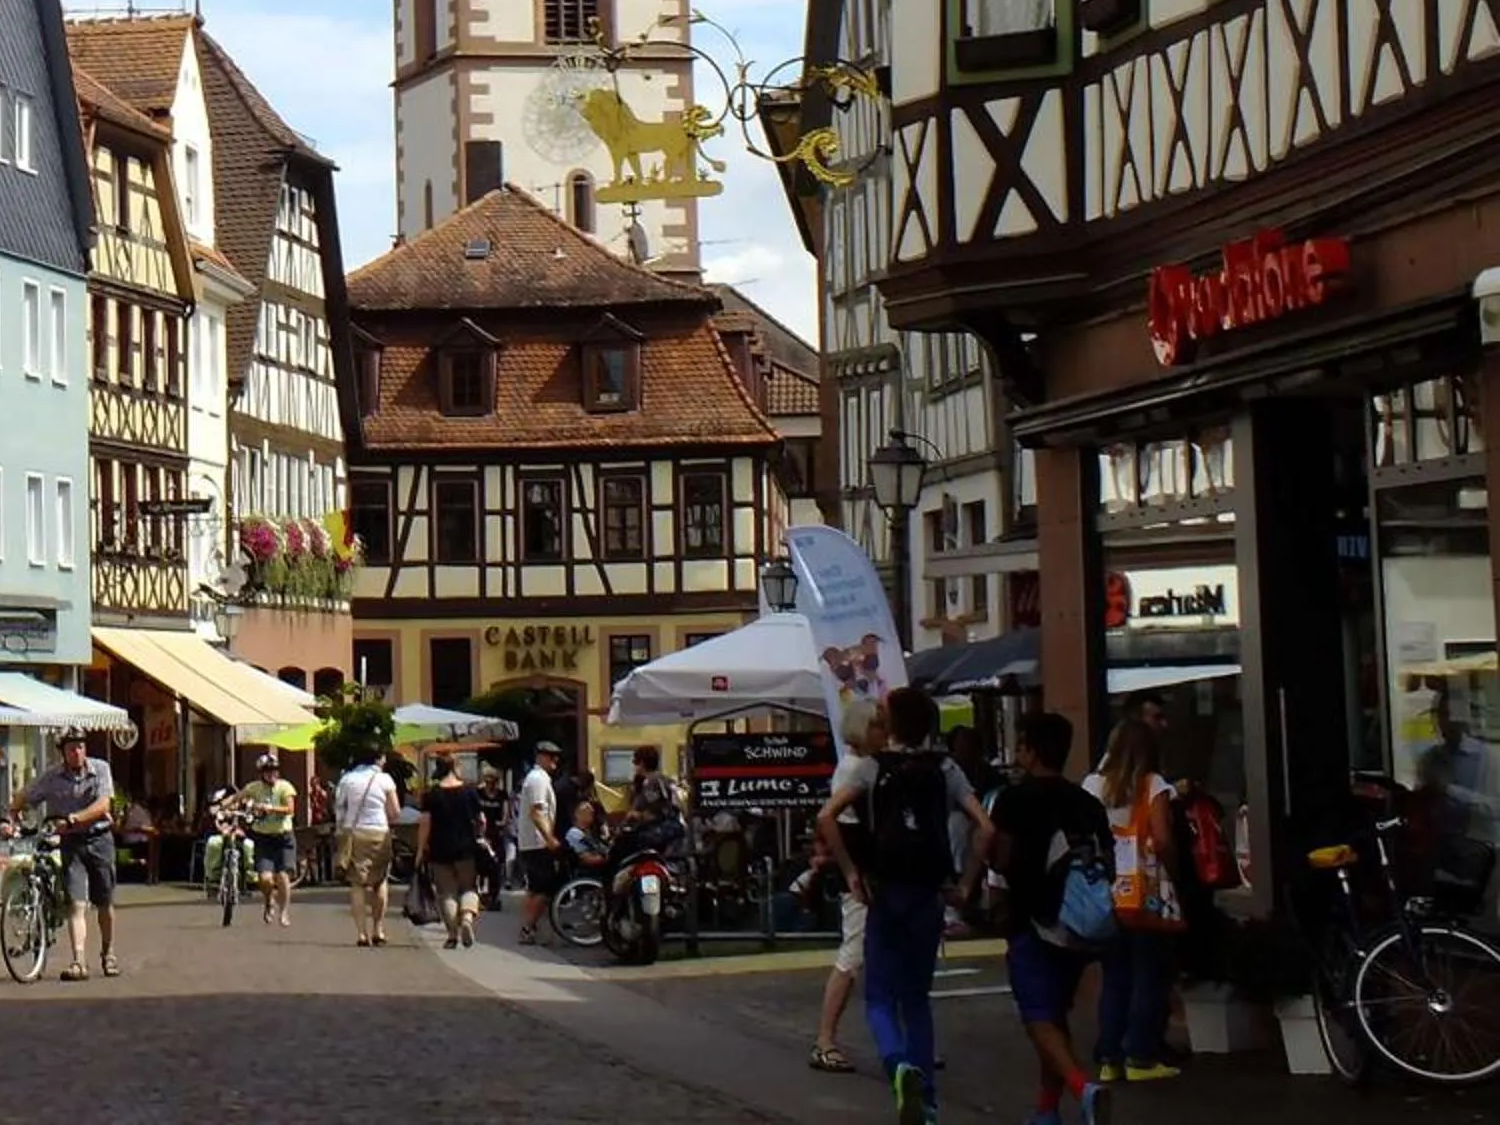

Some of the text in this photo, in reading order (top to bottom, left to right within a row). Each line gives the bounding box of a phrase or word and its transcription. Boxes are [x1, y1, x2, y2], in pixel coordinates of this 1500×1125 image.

[484, 625, 596, 647] CASTELL
[504, 649, 579, 671] BANK
[743, 746, 808, 760] SCHWIND
